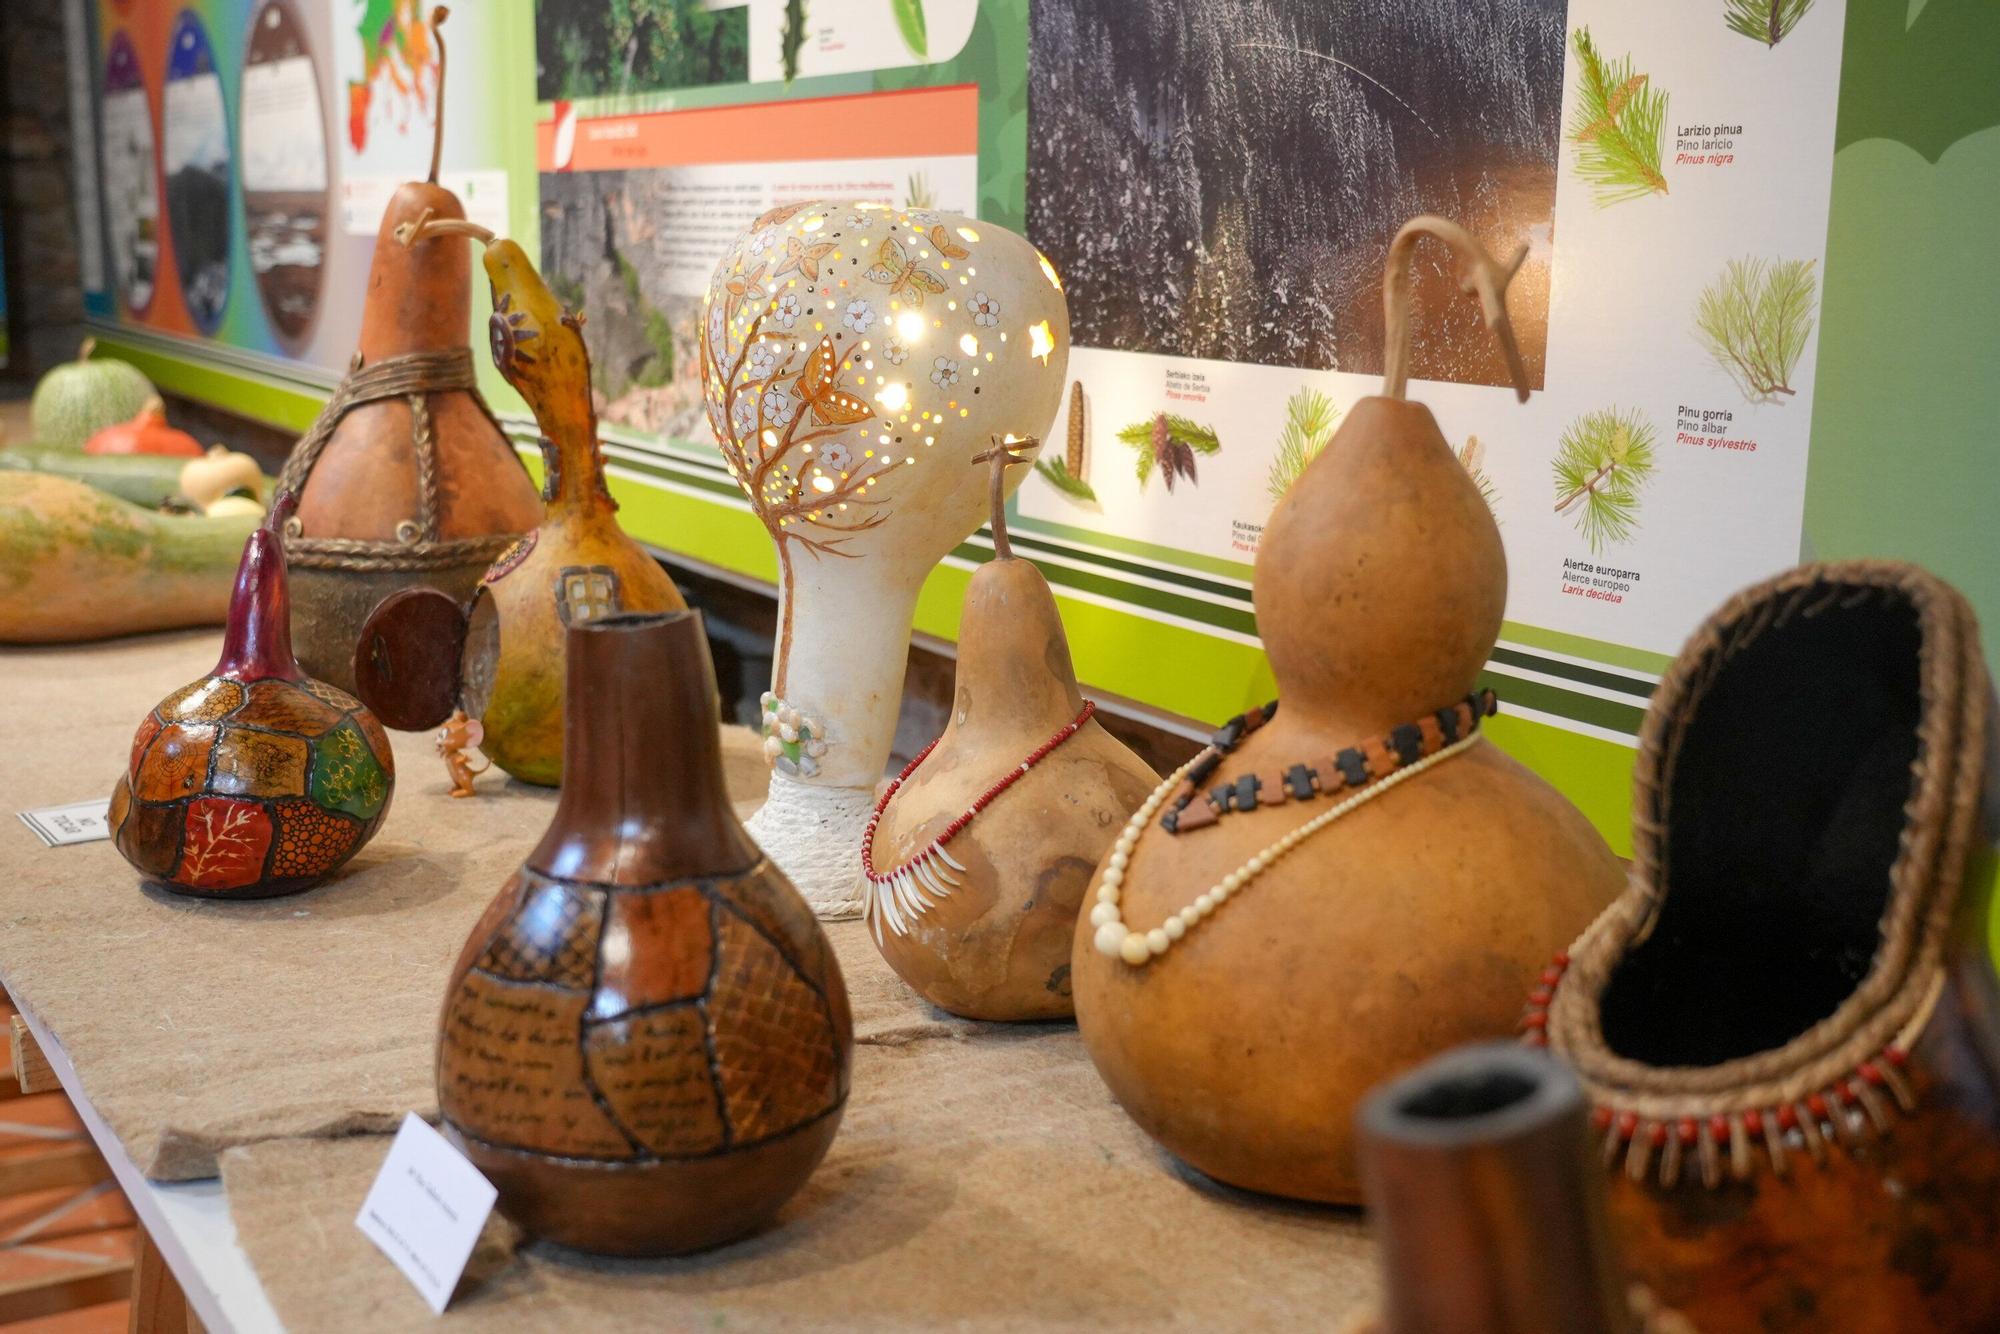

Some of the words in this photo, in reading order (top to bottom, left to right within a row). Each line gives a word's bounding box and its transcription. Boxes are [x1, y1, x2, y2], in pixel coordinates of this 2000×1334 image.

[1677, 125, 1711, 137] Larizio
[1713, 124, 1743, 137] pinua
[1676, 140, 1699, 151] Pino
[1701, 139, 1733, 150] laricio
[1675, 153, 1705, 165] Pinus
[1706, 153, 1734, 167] nigra
[1678, 405, 1700, 418] Pinu
[1702, 409, 1733, 422] gorria
[1676, 419, 1699, 432] Pino
[1701, 422, 1727, 435] albar
[1676, 432, 1705, 446] Pinus
[1706, 437, 1757, 452] sylvestris
[1563, 558, 1594, 573] Alertze
[1595, 565, 1641, 581] europarra
[1562, 571, 1591, 585] Alerce
[1592, 577, 1631, 593] europeo
[1562, 582, 1585, 596] Larix
[1585, 588, 1623, 604] decidua
